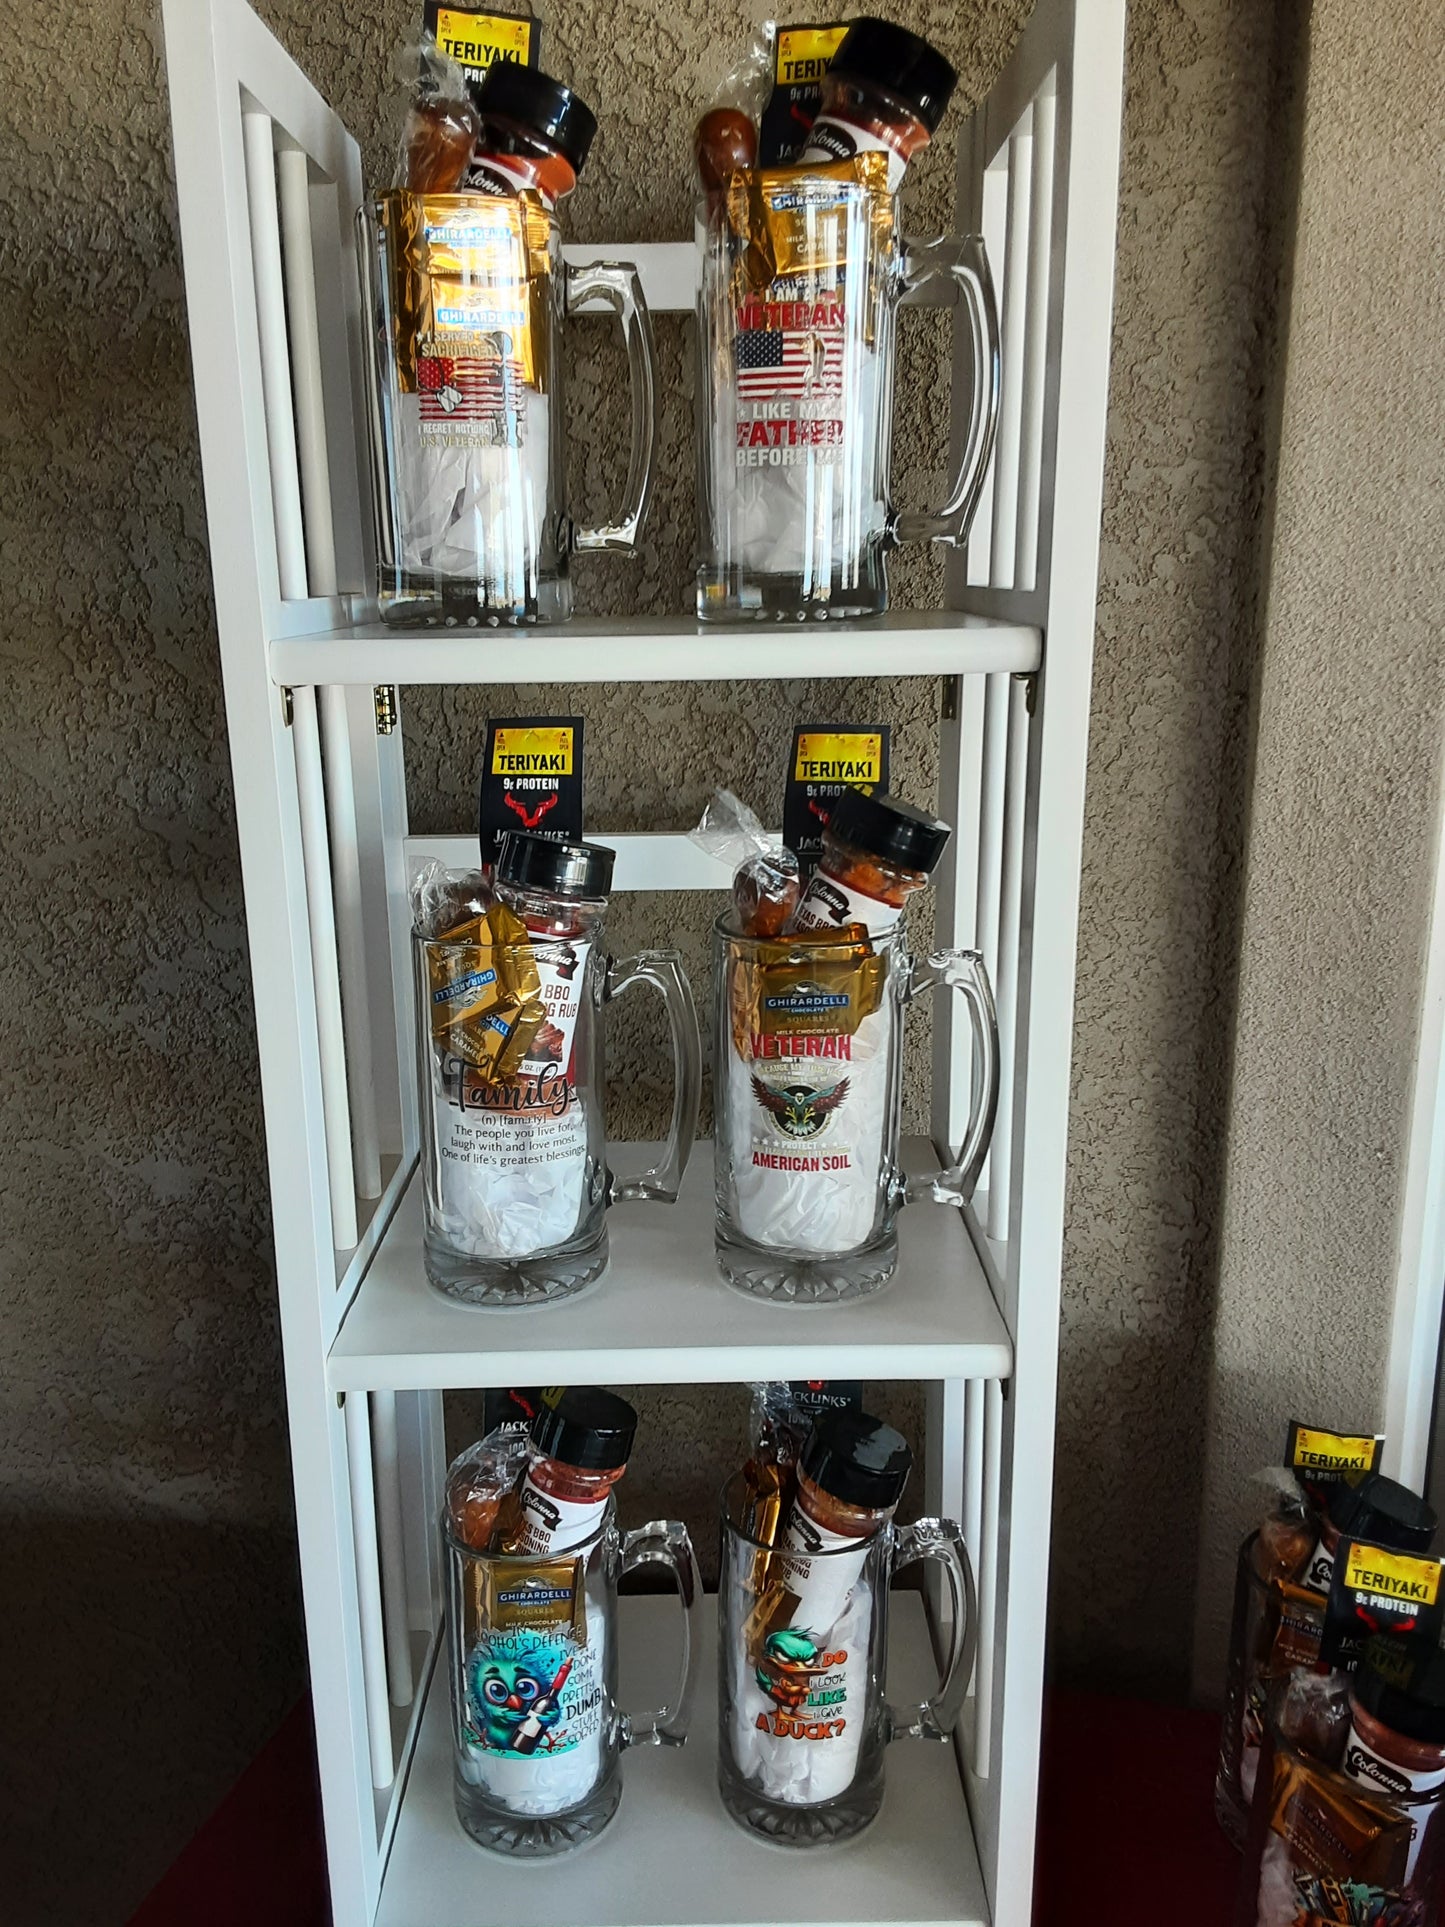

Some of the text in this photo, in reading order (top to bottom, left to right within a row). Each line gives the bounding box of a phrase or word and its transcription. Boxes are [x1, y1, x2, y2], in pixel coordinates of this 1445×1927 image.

[443, 39, 520, 63] TERIYAKI
[784, 57, 832, 80] TERIY
[808, 127, 849, 158] olonna
[776, 287, 798, 302] AM
[737, 303, 845, 330] VETERAN
[753, 402, 790, 419] LIKE
[423, 423, 451, 434] REGRET
[455, 423, 489, 435] NOTHING
[737, 420, 843, 447] FATHER
[736, 448, 807, 467] BEFORE
[499, 754, 565, 770] TERIYAKI
[801, 761, 872, 777] TERIYAKI
[516, 778, 559, 790] PROTEIN
[820, 785, 846, 797] PROT
[797, 836, 824, 850] JAC
[810, 880, 844, 910] Colonna
[434, 969, 496, 1001] GHIRARDELLI
[558, 1003, 577, 1017] RUB
[768, 996, 847, 1007] GHIRARDELLI
[750, 1033, 852, 1060] VETERAN
[447, 1058, 573, 1116] Family
[481, 1115, 497, 1126] (n)
[454, 1125, 473, 1137] The
[476, 1127, 511, 1139] people
[515, 1130, 534, 1140] you
[537, 1126, 555, 1137] live
[451, 1137, 475, 1150] laugh
[479, 1141, 502, 1152] with
[506, 1141, 526, 1152] and
[529, 1140, 550, 1150] love
[782, 1140, 817, 1150] PROTECT
[442, 1147, 459, 1160] One
[460, 1153, 470, 1162] of
[474, 1154, 497, 1165] life's
[500, 1155, 543, 1168] greatest
[752, 1151, 820, 1171] AMERICAN
[822, 1154, 852, 1171] SOIL
[1300, 1450, 1365, 1469] TERIYAKI
[1317, 1471, 1342, 1482] PROT
[523, 1491, 557, 1519] Colonna
[1352, 1568, 1429, 1600] TERIYAKI
[500, 1590, 569, 1601] GHIRARDELLI
[1370, 1594, 1419, 1617] PROTEIN
[574, 1647, 597, 1671] DONE
[822, 1649, 848, 1668] DO
[568, 1665, 593, 1687] SOME
[817, 1671, 846, 1688] LOOK
[563, 1680, 595, 1704] PRETTY
[807, 1687, 847, 1706] LIKE
[567, 1688, 600, 1720] DUMB
[756, 1713, 847, 1740] A DUCK?
[1351, 1751, 1408, 1793] Colonna
